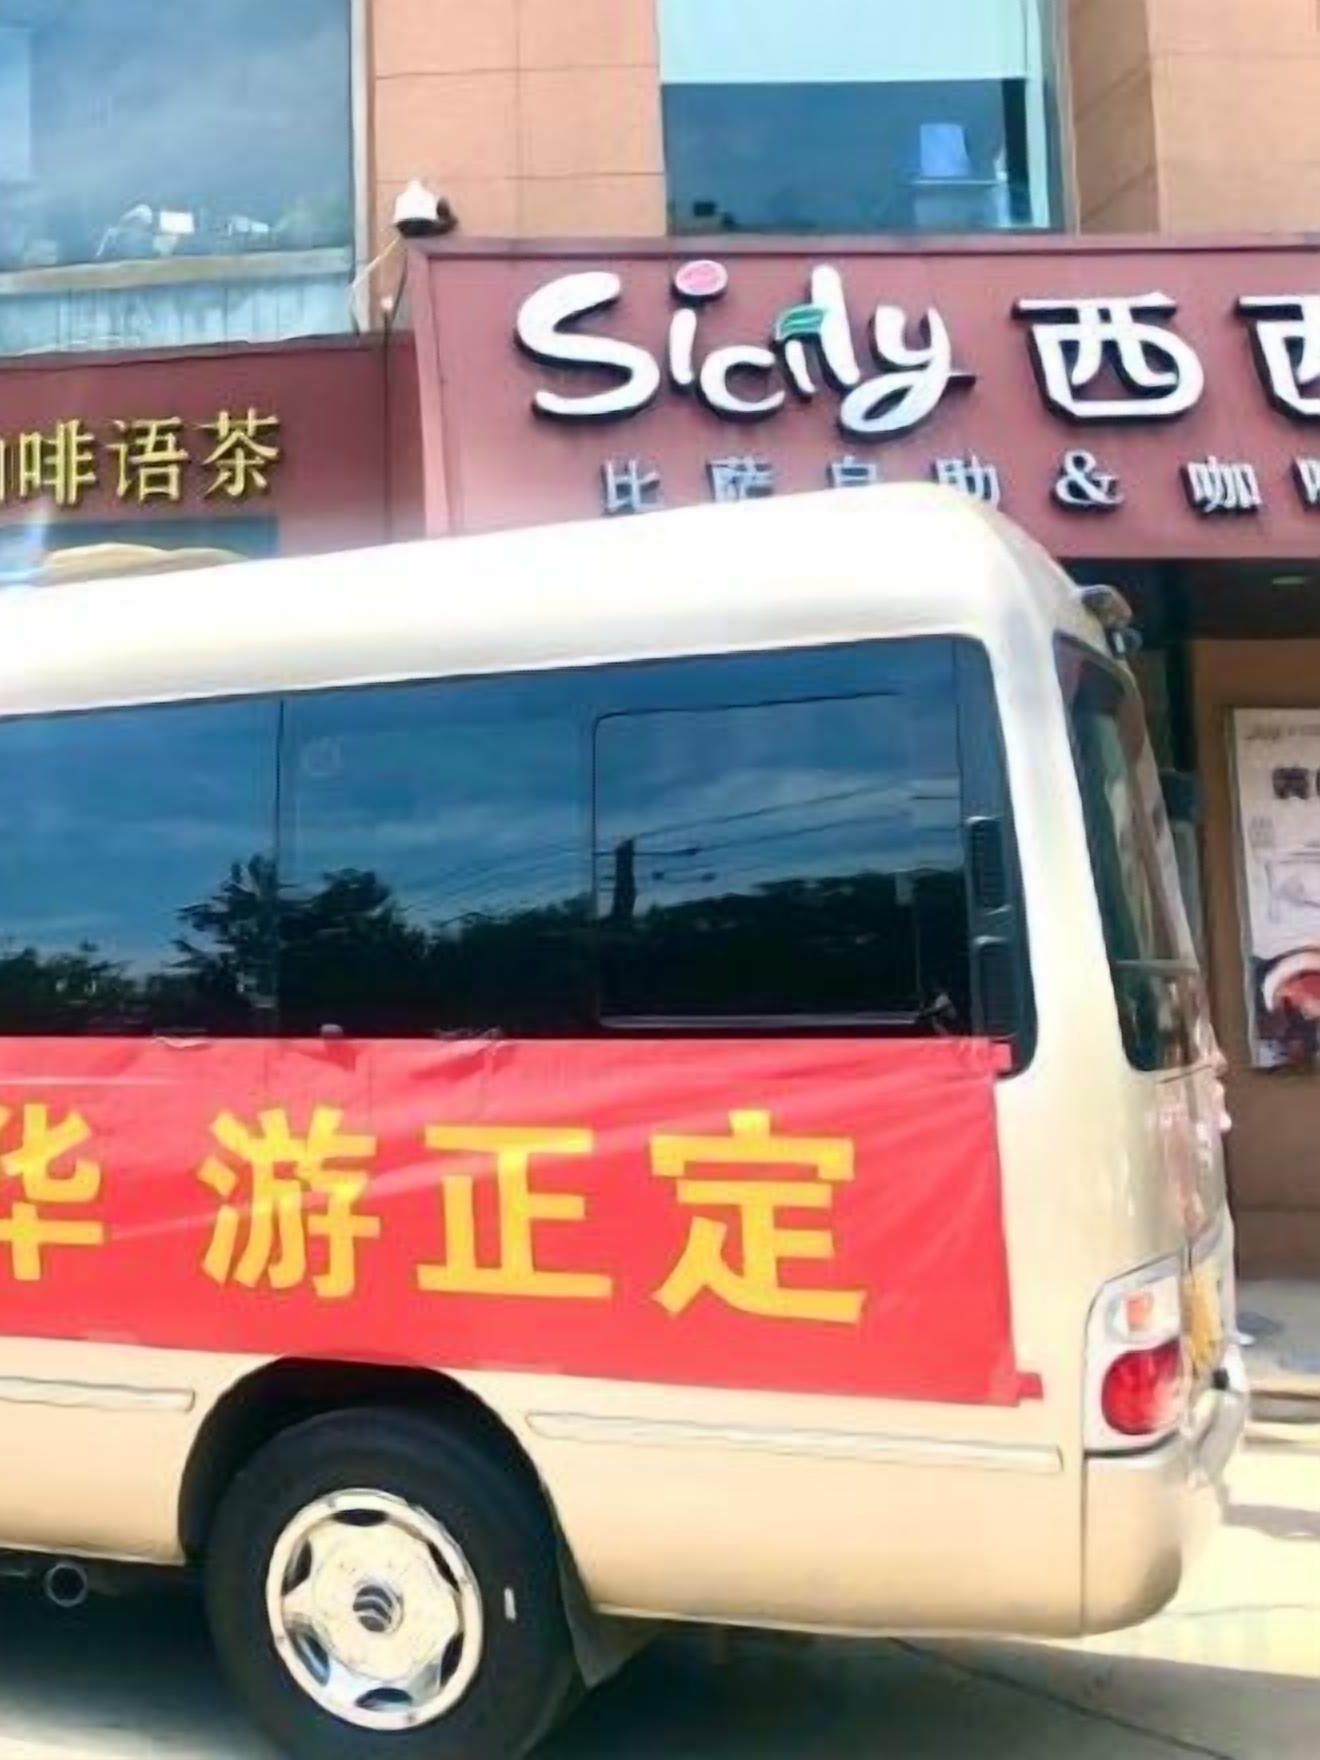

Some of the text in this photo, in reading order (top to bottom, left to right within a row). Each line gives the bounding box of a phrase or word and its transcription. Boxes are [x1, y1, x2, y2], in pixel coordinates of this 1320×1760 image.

[516, 259, 972, 434] Sicily
[1055, 450, 1123, 504] &
[197, 1103, 866, 1323] 游正定
